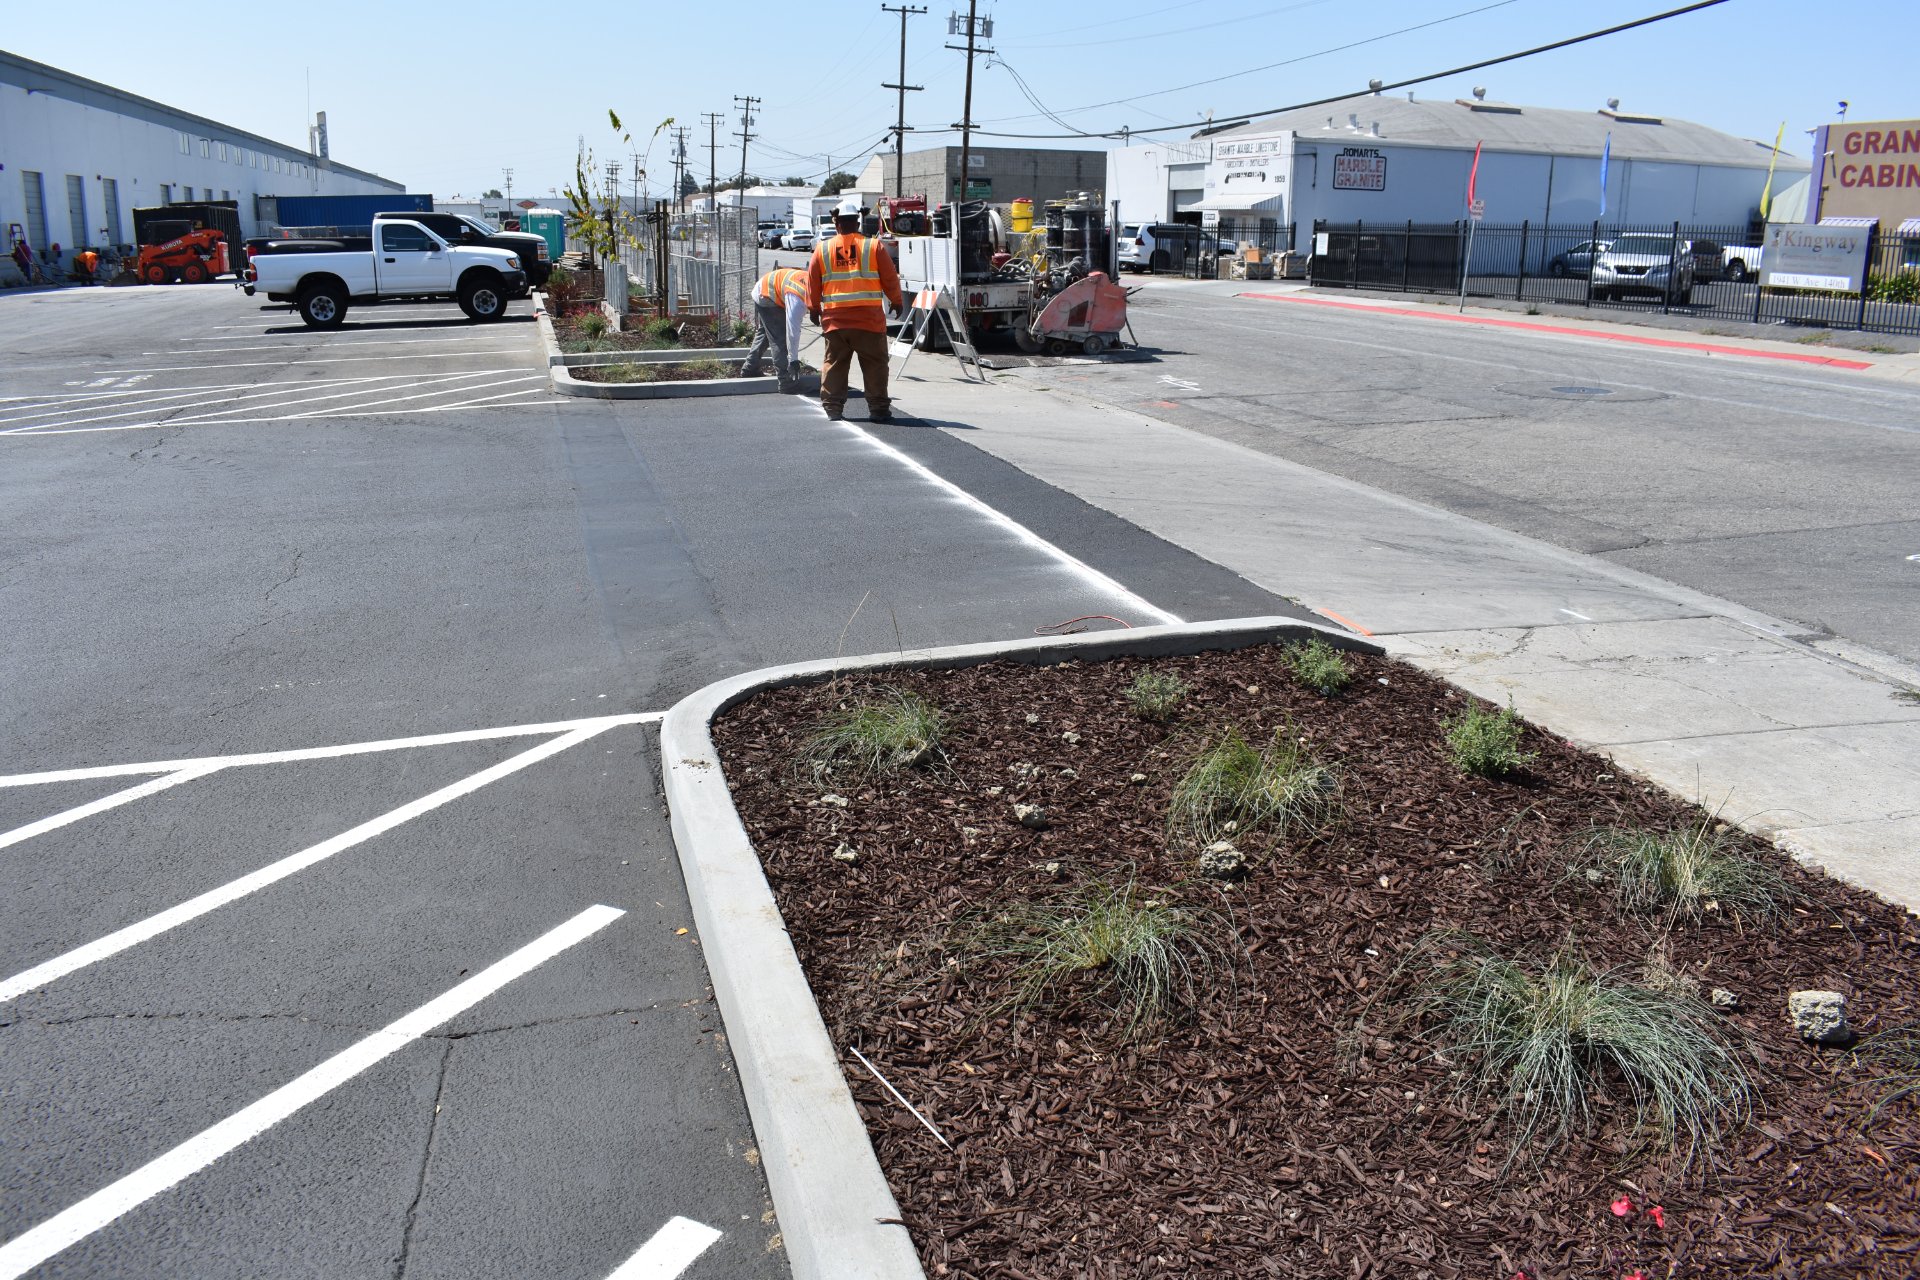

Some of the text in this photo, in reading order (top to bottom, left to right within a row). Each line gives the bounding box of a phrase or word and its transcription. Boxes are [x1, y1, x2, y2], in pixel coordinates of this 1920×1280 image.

[1343, 147, 1380, 159] ROMARTS
[1337, 158, 1384, 173] MARBLE
[1336, 172, 1383, 188] GRANITE
[161, 239, 183, 251] KUBOTA
[1784, 230, 1858, 254] Kingway
[1773, 274, 1789, 284] 1941
